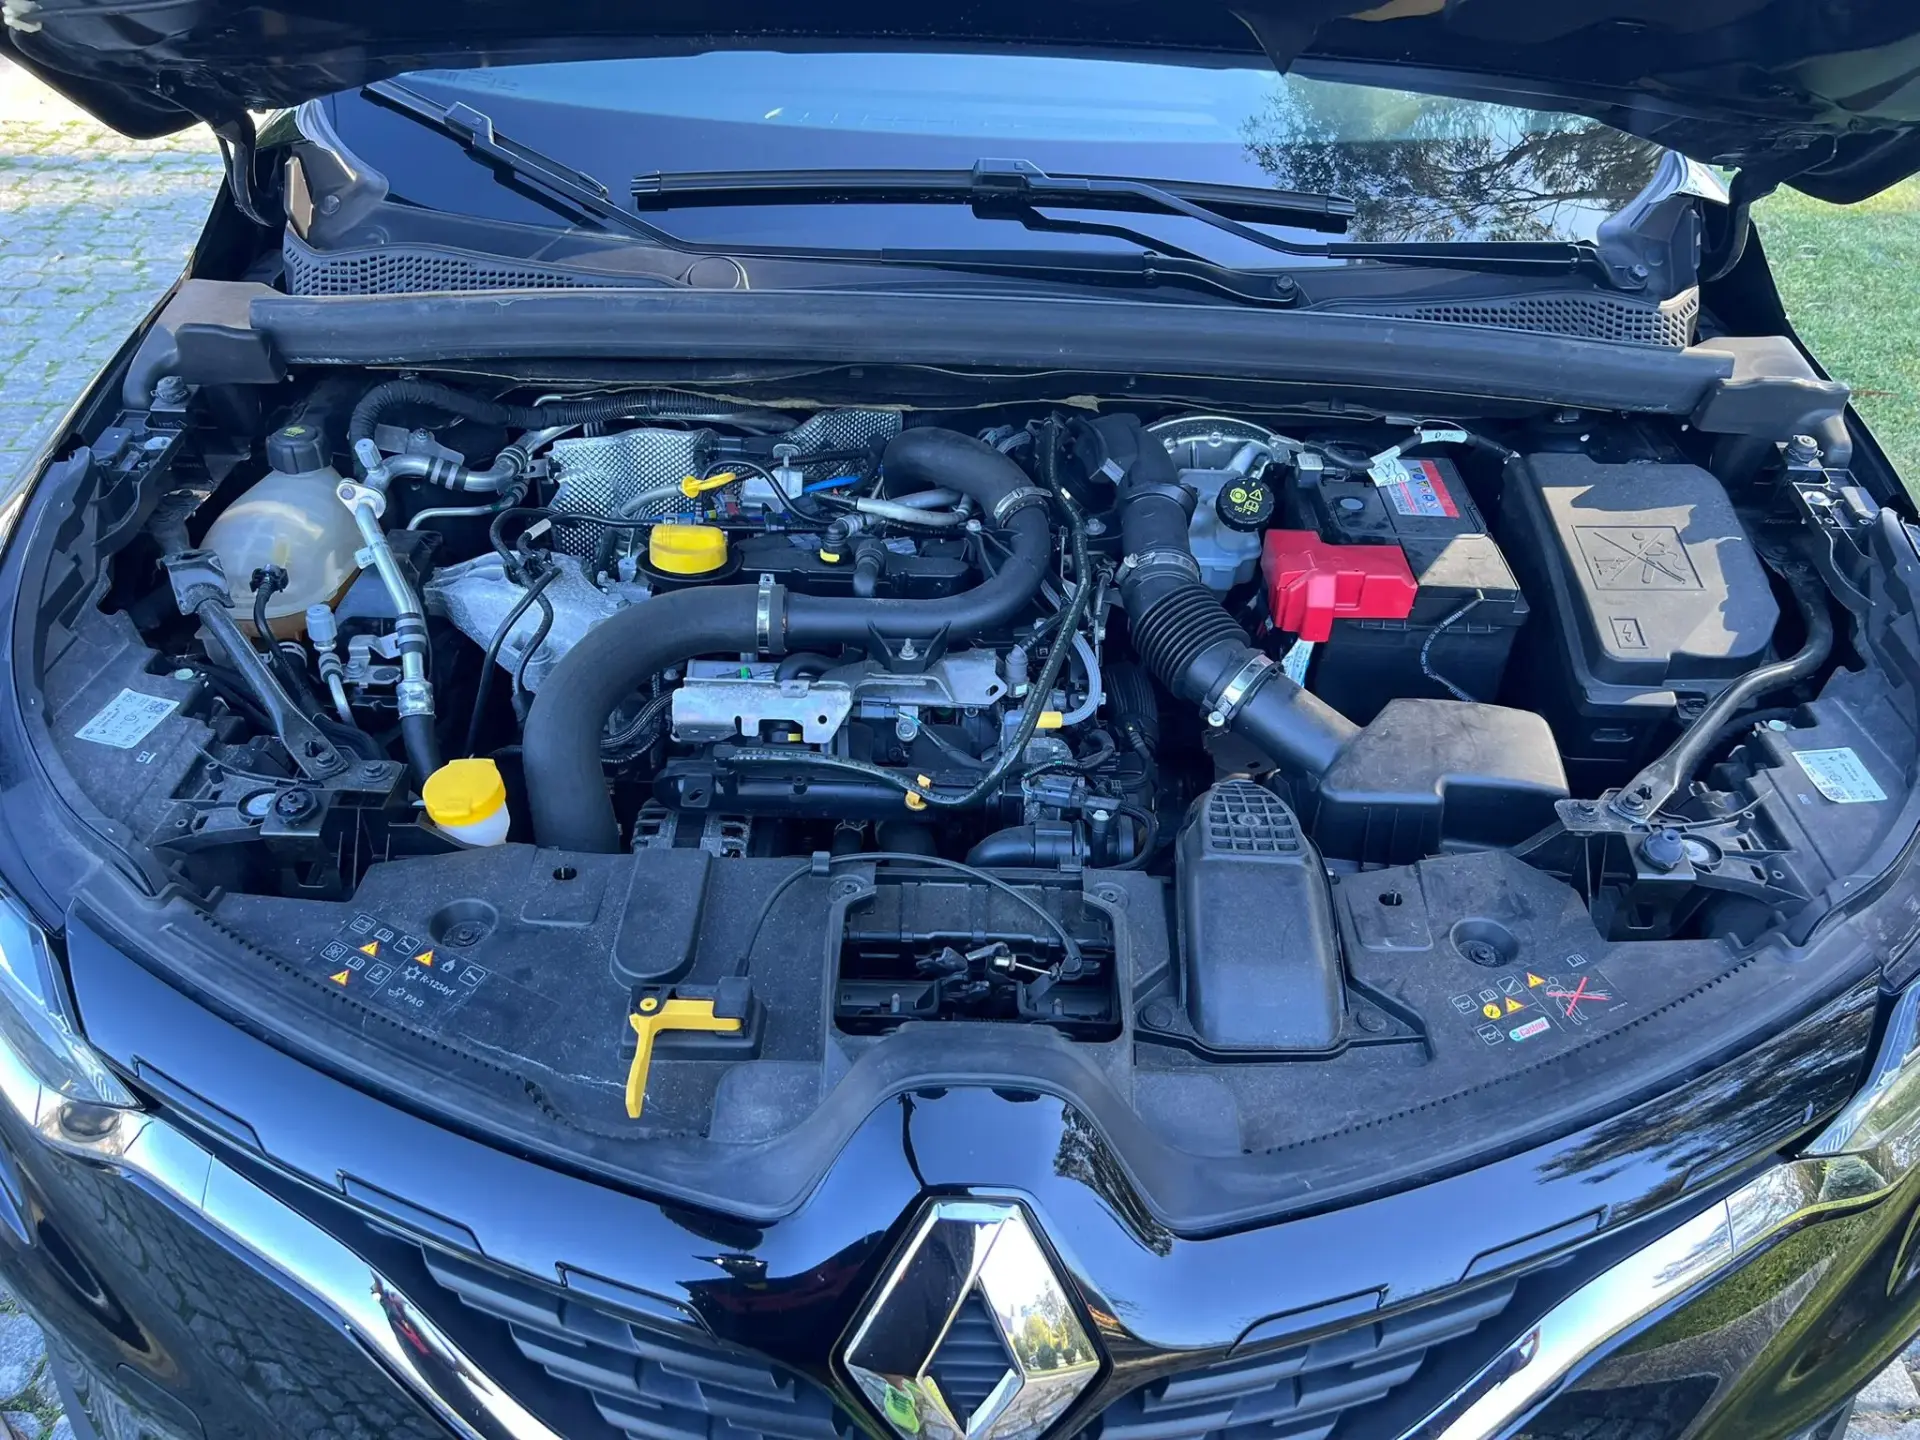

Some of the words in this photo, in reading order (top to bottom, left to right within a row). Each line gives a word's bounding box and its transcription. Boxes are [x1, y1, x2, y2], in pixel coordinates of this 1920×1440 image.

[1234, 505, 1245, 514] DOT
[420, 974, 457, 996] R-1234yf
[404, 994, 424, 1008] PAG
[1519, 1019, 1546, 1037] Castrol
